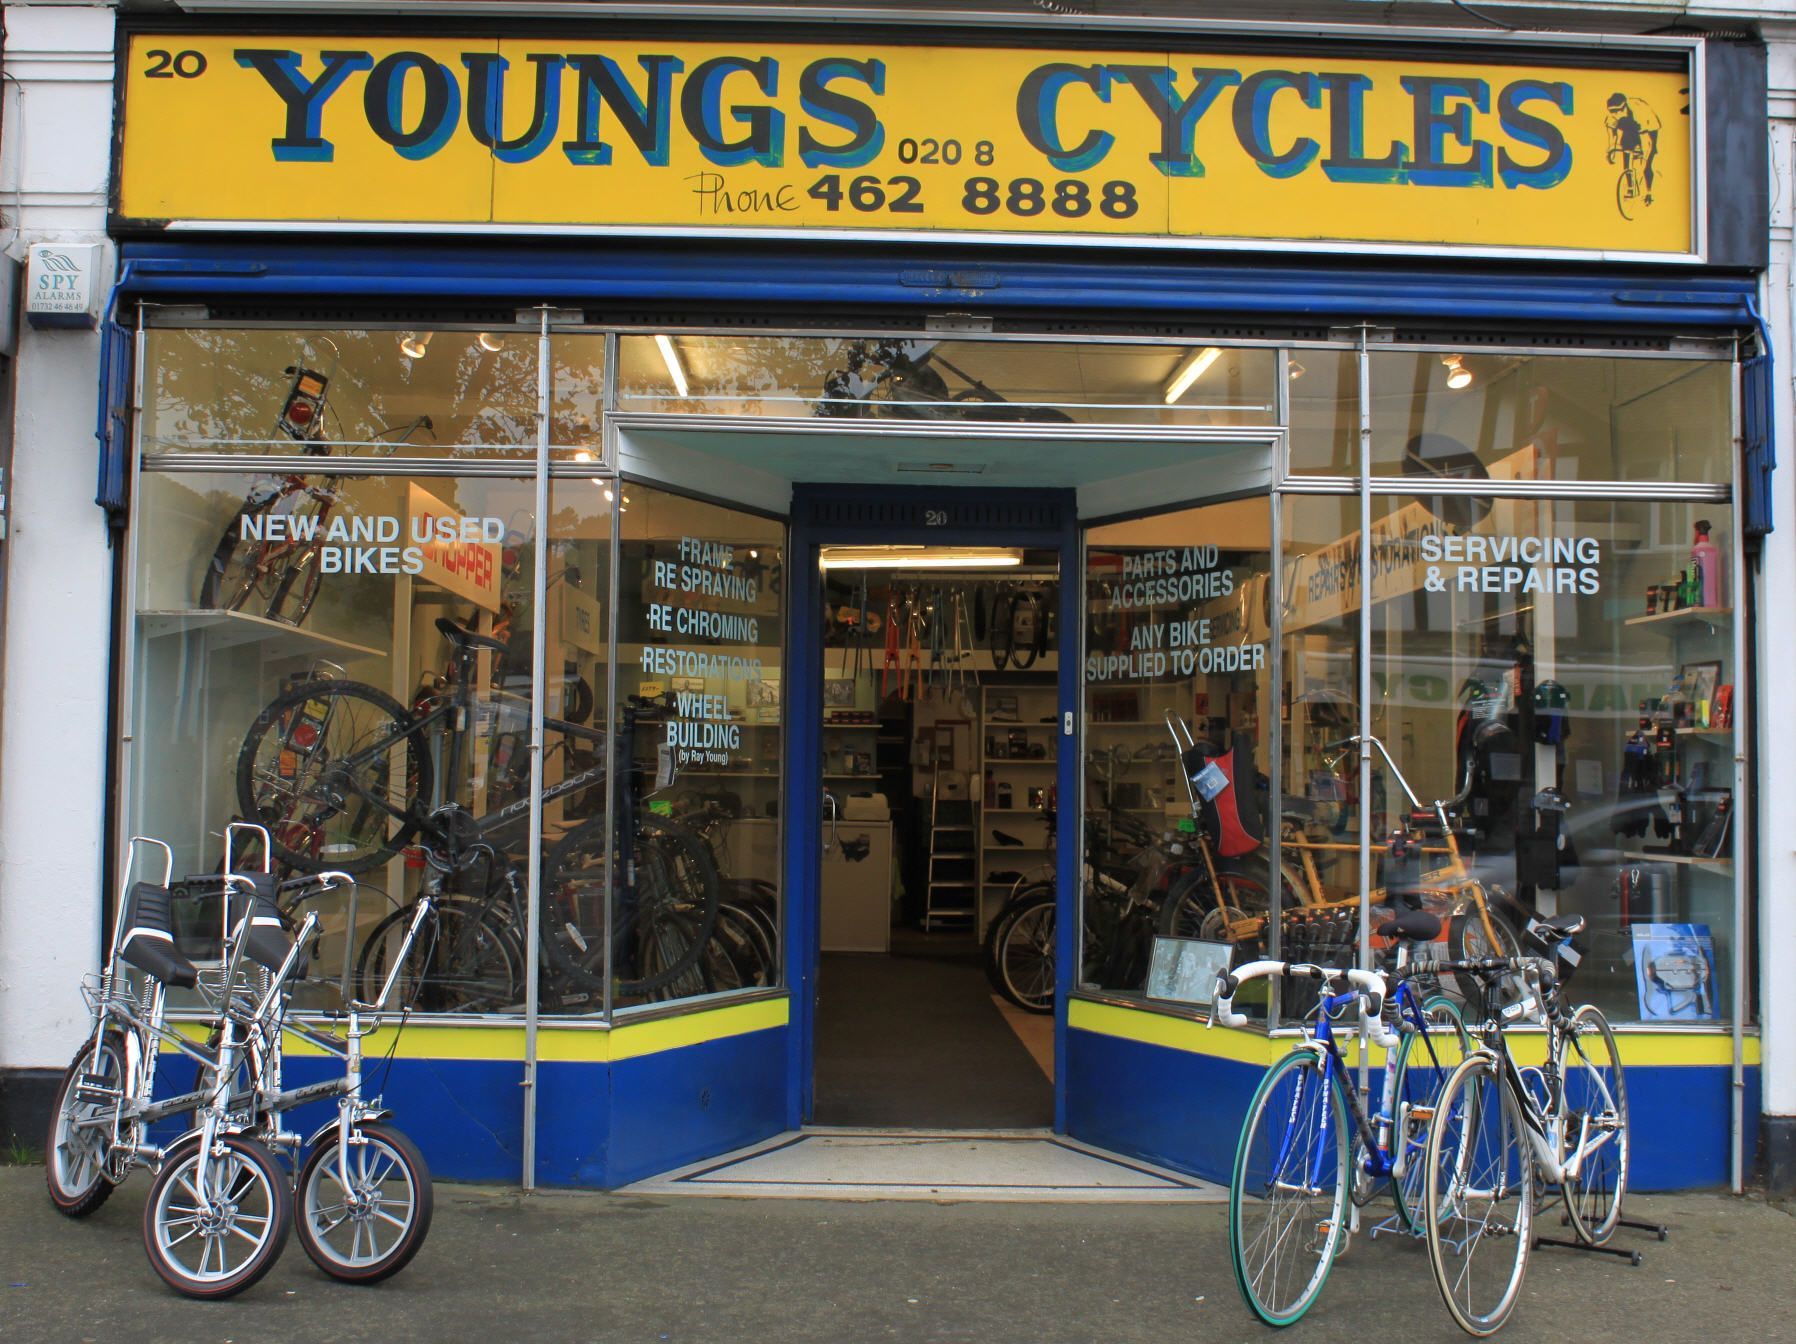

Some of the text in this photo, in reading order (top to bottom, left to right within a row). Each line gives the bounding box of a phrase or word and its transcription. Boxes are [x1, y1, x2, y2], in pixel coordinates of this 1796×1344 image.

[143, 49, 208, 79] 20
[233, 48, 1574, 190] YOUNGS CYCLES
[898, 138, 995, 166] 020 8
[683, 170, 1139, 219] Phone 462 8888
[34, 291, 83, 301] ALARMS
[39, 274, 80, 290] SPY
[240, 514, 319, 542] NEW
[326, 515, 400, 542] AND
[411, 516, 506, 544] USED
[925, 510, 948, 526] 20
[320, 546, 424, 575] BIKES
[1122, 543, 1219, 580] PARTS AND
[1421, 535, 1600, 564] SERVICING
[654, 561, 757, 603] RE SPRAYING
[1111, 570, 1234, 609] ACCESSORIES
[1423, 565, 1600, 595] & REPAIRS
[650, 604, 759, 643] RE CHROMING
[1130, 623, 1165, 651] ANY
[1169, 619, 1211, 647] BIKE
[643, 646, 763, 684] RESTORATIONS
[1087, 643, 1265, 681] SUPPLIED TO ORDER
[676, 691, 732, 720] WHEEL
[666, 722, 740, 750] BUILDING
[691, 749, 705, 764] Ray
[706, 750, 729, 765] Young)
